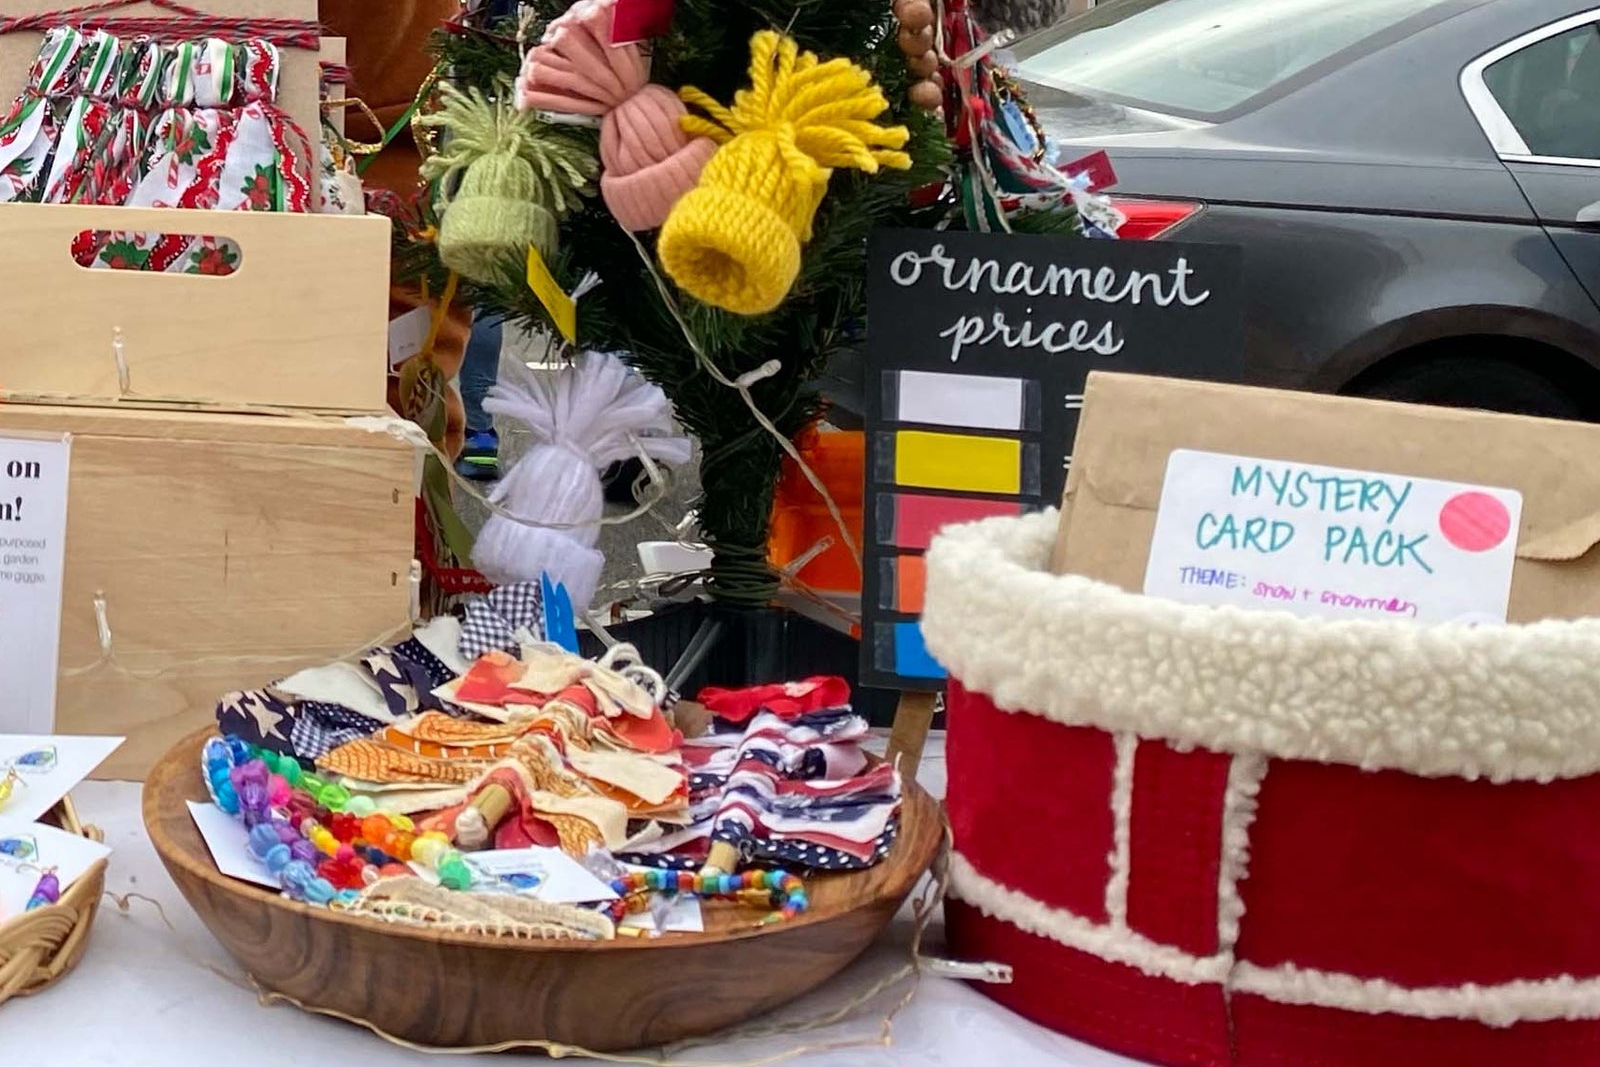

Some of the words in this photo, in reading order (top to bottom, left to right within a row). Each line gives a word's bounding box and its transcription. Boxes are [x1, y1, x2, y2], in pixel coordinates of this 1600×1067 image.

[890, 243, 1211, 307] ornament
[938, 308, 1125, 362] prices
[6, 460, 42, 479] on
[1231, 465, 1413, 524] MYSTERY
[1196, 513, 1295, 554] CARD
[1324, 525, 1434, 575] PACK
[1179, 566, 1247, 589] THEME:
